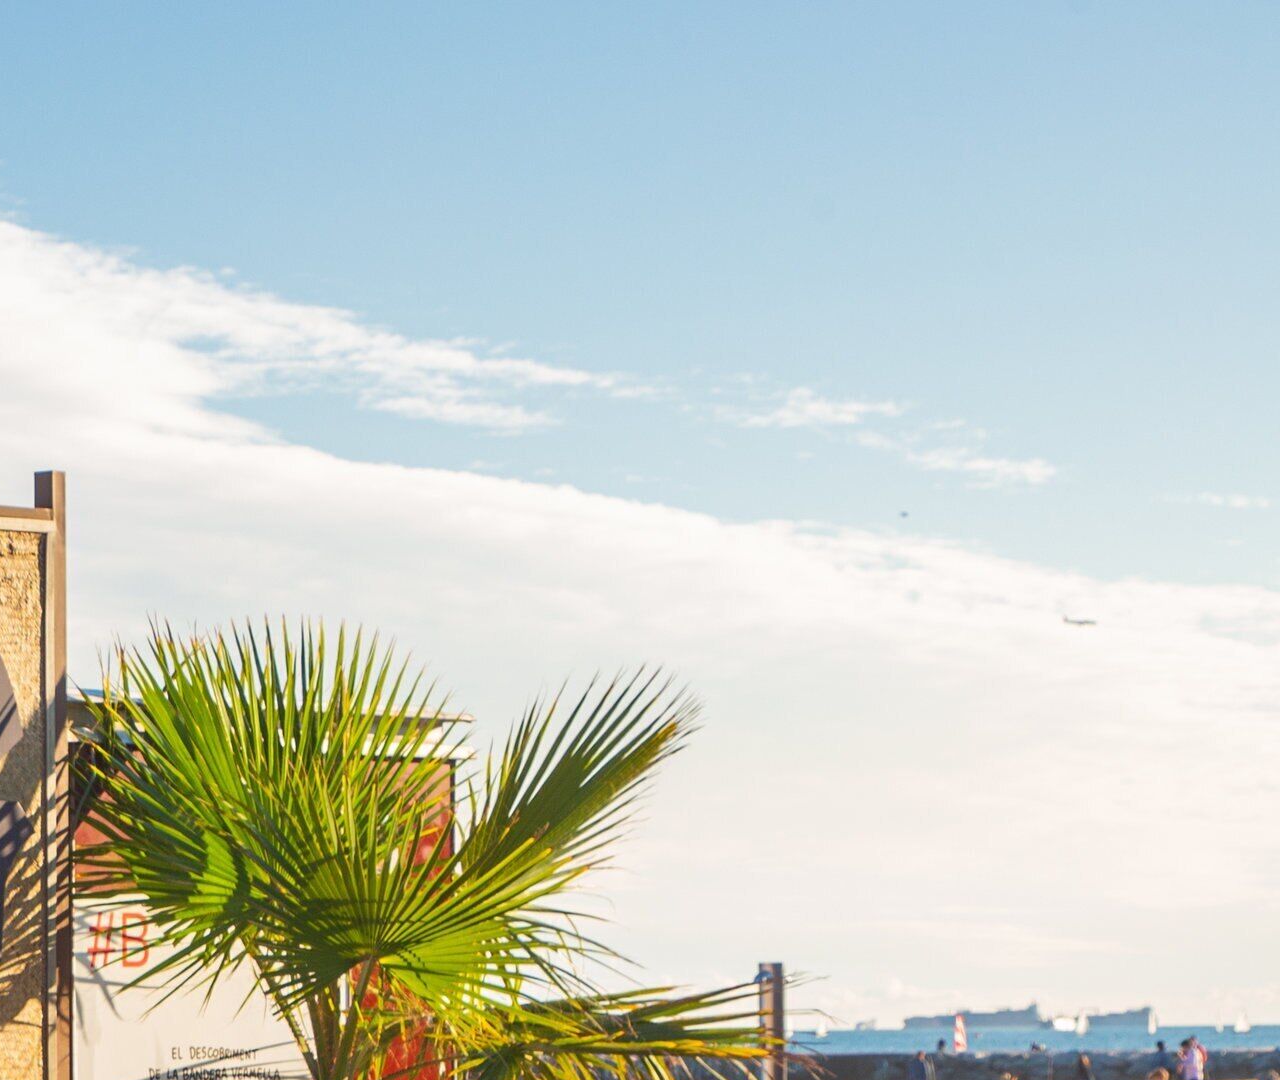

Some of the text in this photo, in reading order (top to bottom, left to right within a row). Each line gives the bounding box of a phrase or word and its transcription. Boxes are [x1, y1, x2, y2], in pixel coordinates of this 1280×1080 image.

[171, 1046, 257, 1061] EL DESCOBRIMENT
[148, 1068, 161, 1080] DE
[166, 1069, 179, 1080] LA
[231, 1067, 281, 1080] VERMELLA
